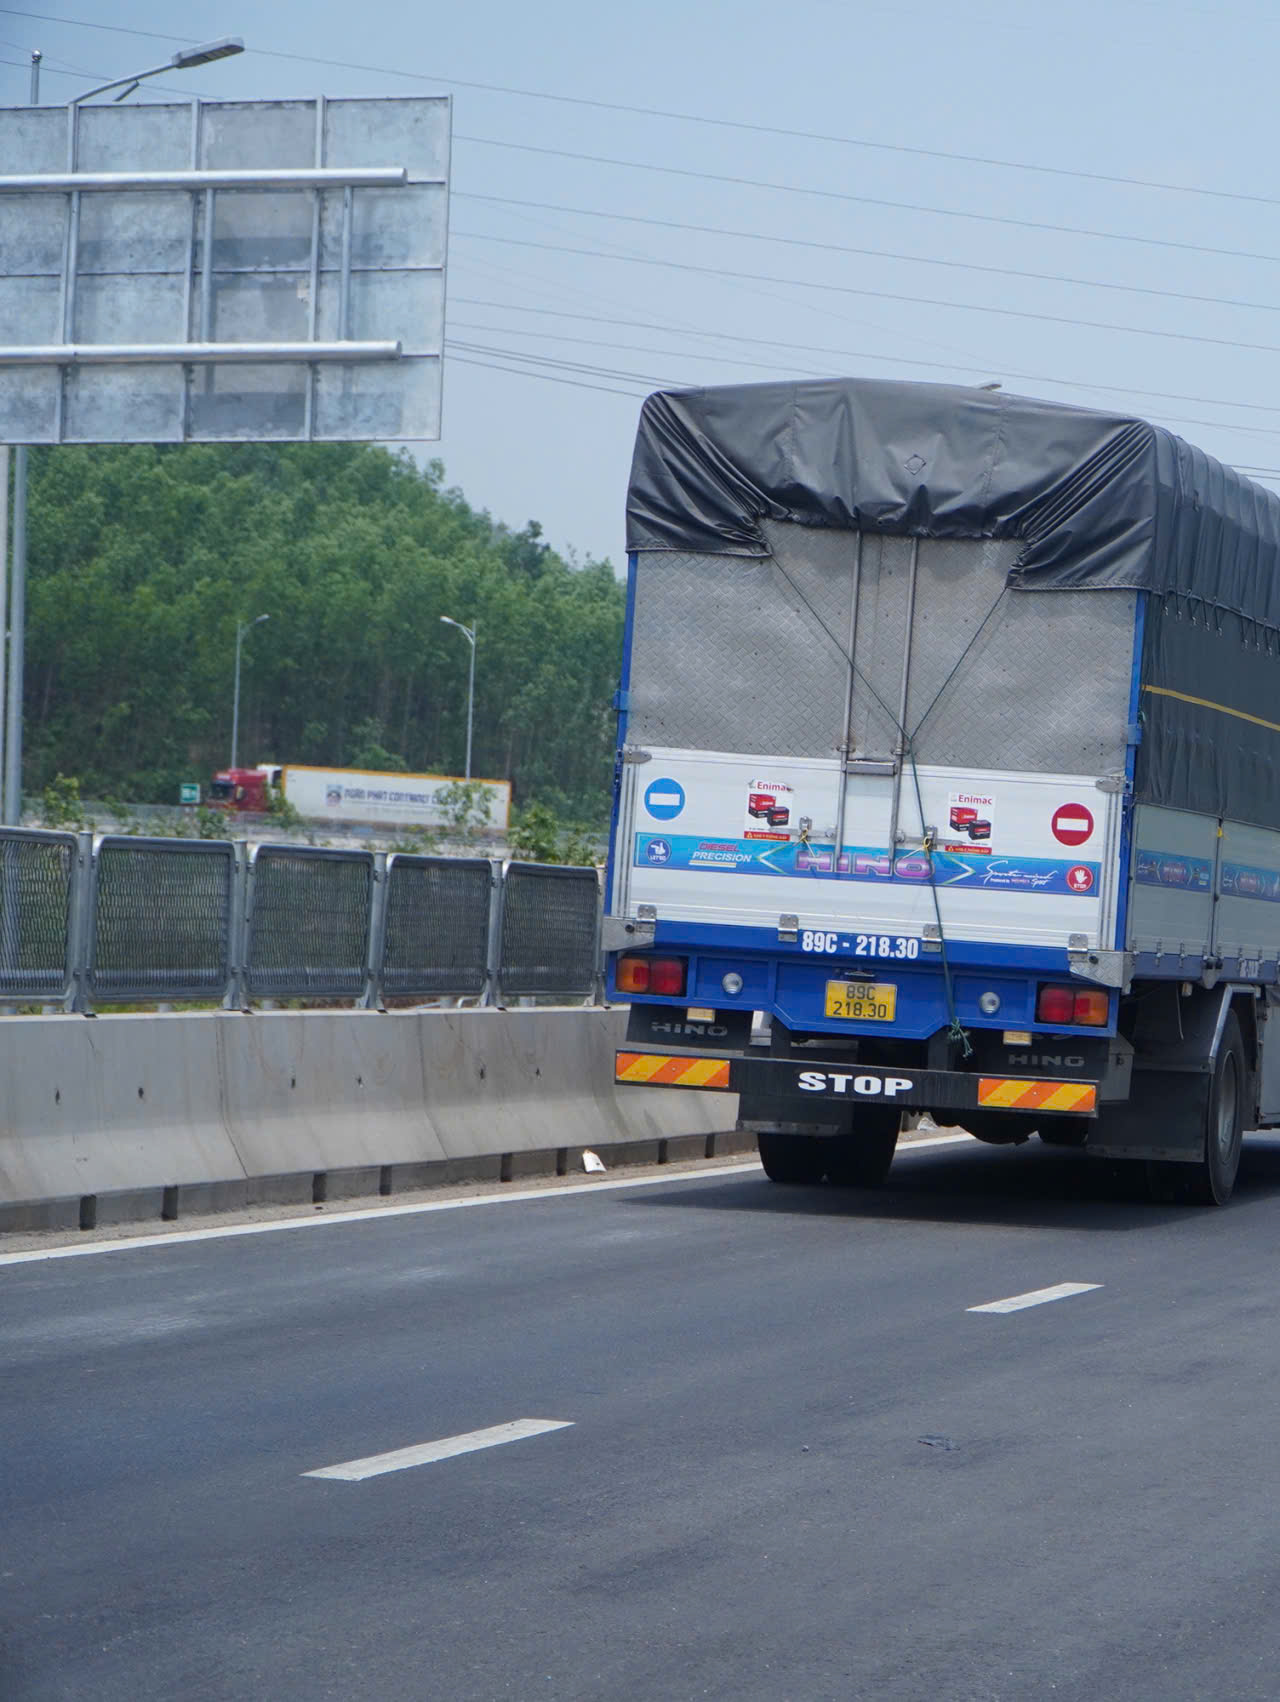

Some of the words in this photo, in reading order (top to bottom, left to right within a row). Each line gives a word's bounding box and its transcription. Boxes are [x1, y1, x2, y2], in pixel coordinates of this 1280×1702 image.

[958, 794, 992, 805] Enimac
[692, 851, 752, 863] PRECISION
[795, 850, 935, 880] HINO
[802, 931, 838, 953] 89C
[855, 935, 919, 959] 218.30
[846, 985, 876, 1001] 89C
[833, 1001, 888, 1018] 218.30
[651, 1022, 728, 1036] HINO
[1008, 1054, 1085, 1067] HINO
[798, 1071, 913, 1096] STOP
